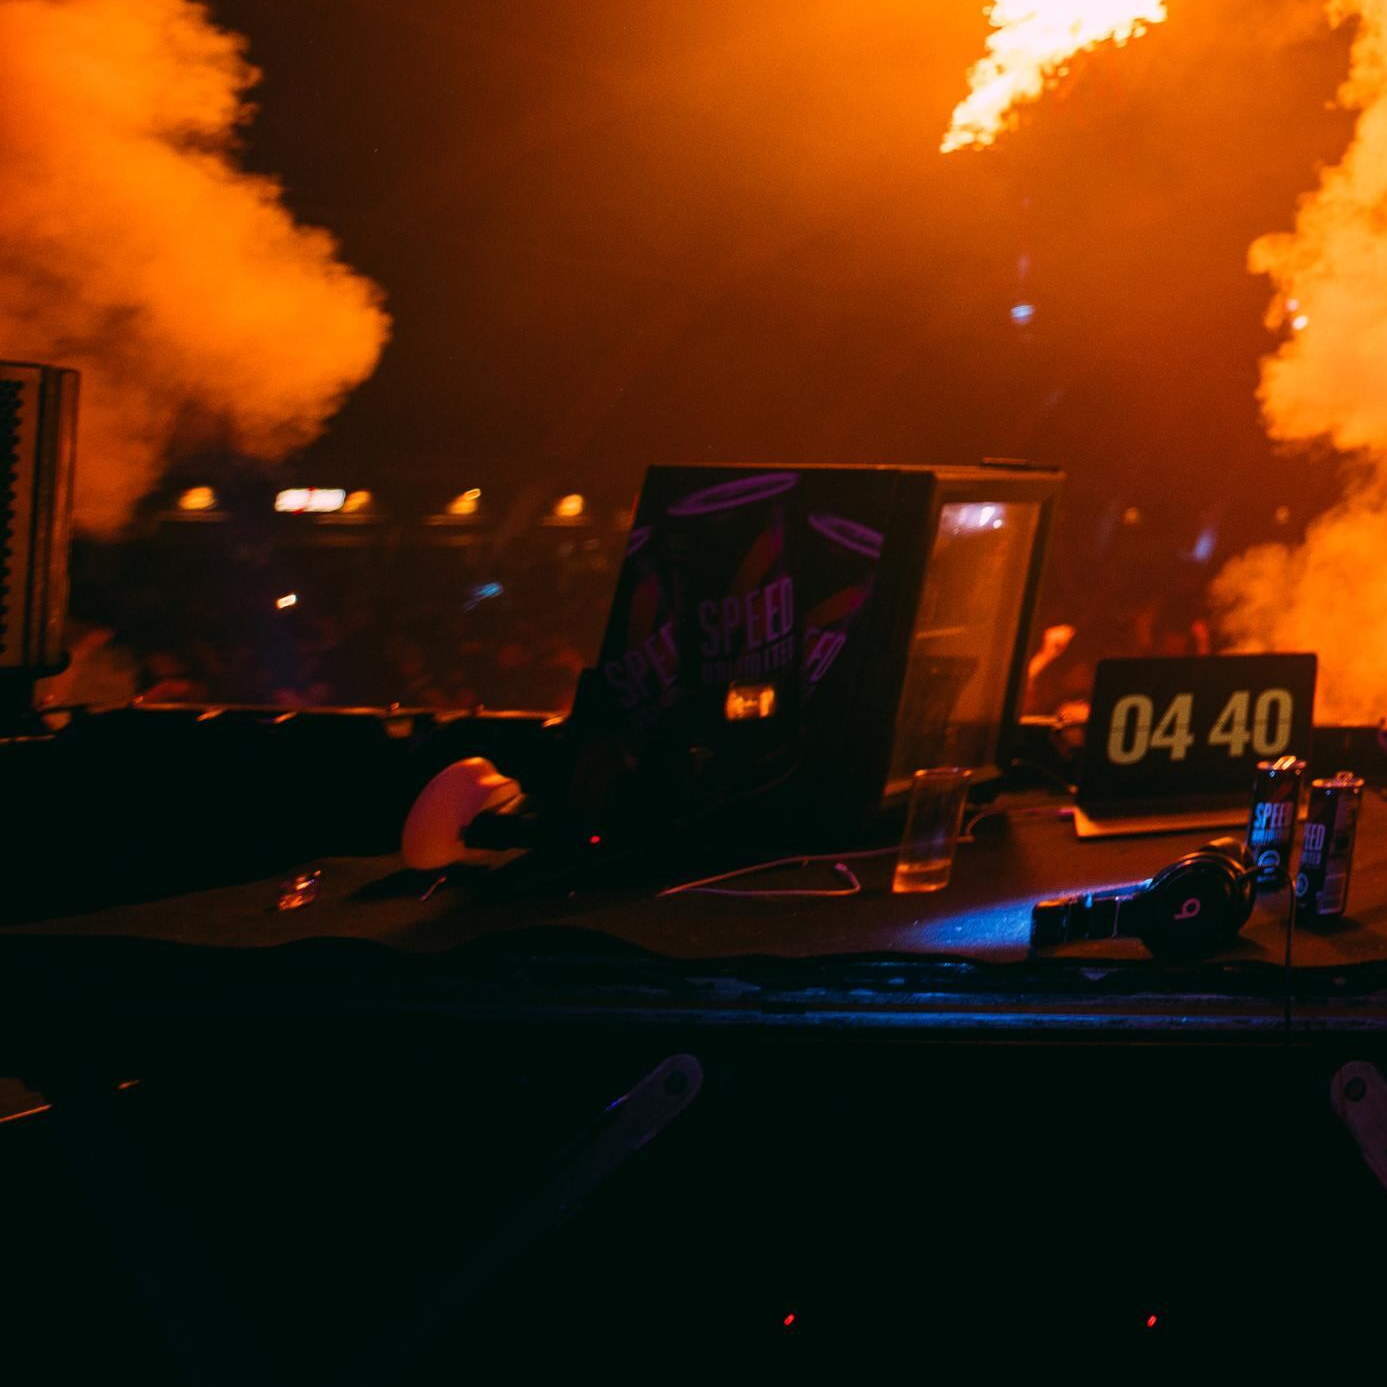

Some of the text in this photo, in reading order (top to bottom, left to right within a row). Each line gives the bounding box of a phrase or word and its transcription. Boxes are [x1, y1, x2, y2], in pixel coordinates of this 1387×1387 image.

[699, 573, 796, 657] SPEED
[1106, 687, 1294, 766] 04 40
